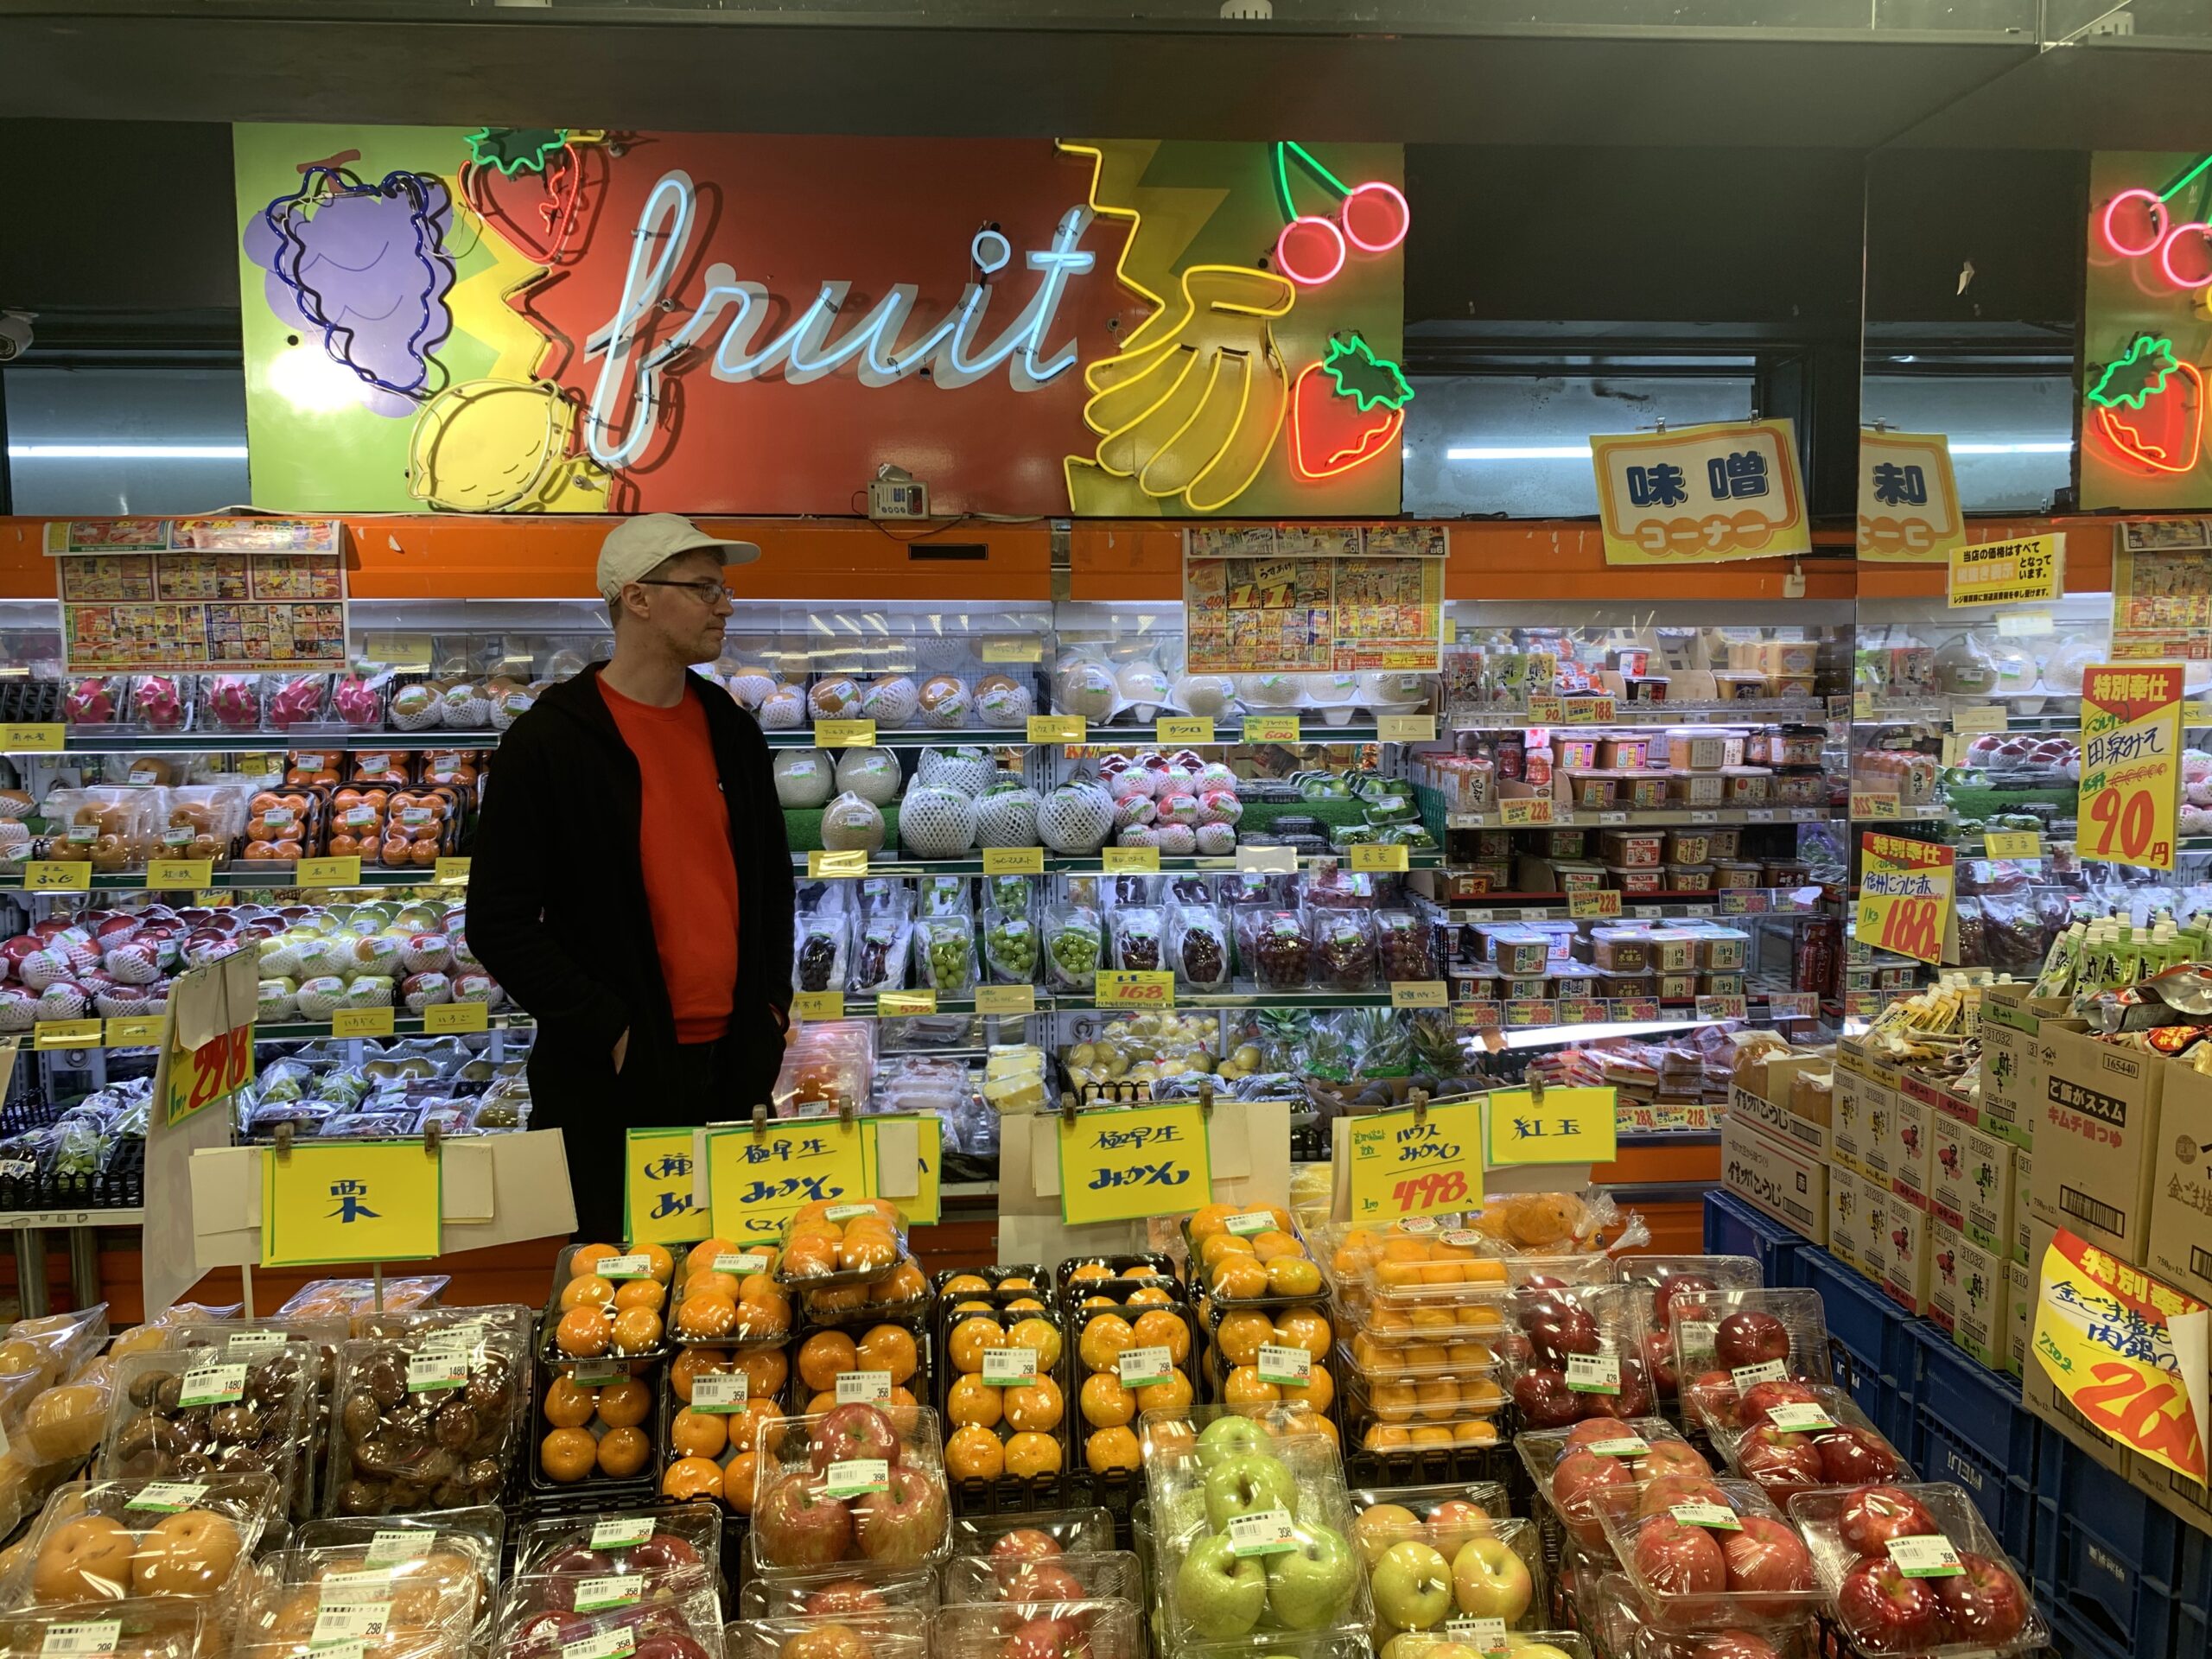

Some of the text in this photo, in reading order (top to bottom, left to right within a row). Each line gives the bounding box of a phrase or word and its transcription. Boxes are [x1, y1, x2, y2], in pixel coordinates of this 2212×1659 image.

[584, 170, 1094, 467] fruit
[1626, 451, 1768, 508] 味噌
[1640, 519, 1767, 550] コーナー
[1963, 542, 2040, 562] 当店の価格はすべて
[2019, 555, 2051, 568] となって
[2019, 568, 2047, 579] います。
[2093, 673, 2169, 702] 特別奉仕
[1545, 709, 1559, 720] 90
[1594, 701, 1611, 720] 188
[1264, 731, 1294, 740] 600
[2088, 727, 2164, 768] 田楽みそ
[1530, 802, 1548, 821] 228
[2091, 787, 2169, 866] 90 円
[1872, 836, 1941, 865] 特別奉仕
[1863, 870, 1932, 896] 信州こうじ赤
[1599, 893, 1617, 913] 228
[1881, 899, 1937, 959] 188
[1122, 985, 1163, 1000] 168
[1725, 998, 1742, 1018] 338
[1796, 995, 1815, 1016] 578
[1986, 1028, 2012, 1046] 31032
[2106, 1056, 2137, 1077] 165440
[2049, 1078, 2125, 1125] ご飯がススム
[1634, 1109, 1653, 1128] 288
[1687, 1109, 1705, 1126] 218
[2048, 1106, 2123, 1148] キムチ鍋つゆ
[1092, 1124, 1184, 1149] 極早生
[1396, 1123, 1441, 1144] ハウス
[1511, 1115, 1582, 1140] 紅玉
[736, 1138, 836, 1163] 極早生
[1399, 1143, 1460, 1162] みかん
[1969, 1136, 1994, 1158] 31032
[1089, 1160, 1190, 1190] みかん
[740, 1174, 844, 1204] みかん
[1392, 1171, 1468, 1211] 498
[322, 1179, 383, 1224] 栗
[1961, 1247, 1985, 1269] 31032
[448, 1366, 466, 1376] 1480
[616, 1363, 628, 1373] 298
[1023, 1363, 1034, 1375] 298
[1159, 1363, 1170, 1373] 298
[1297, 1364, 1308, 1375] 298
[225, 1380, 242, 1391] 1480
[1605, 1373, 1618, 1383] 428
[733, 1390, 745, 1402] 358
[877, 1388, 889, 1398] 358
[873, 1473, 886, 1482] 398
[638, 1528, 650, 1536] 358
[1278, 1527, 1291, 1538] 398
[625, 1587, 639, 1596] 358
[365, 1622, 383, 1635] 298
[615, 1638, 631, 1649] 358
